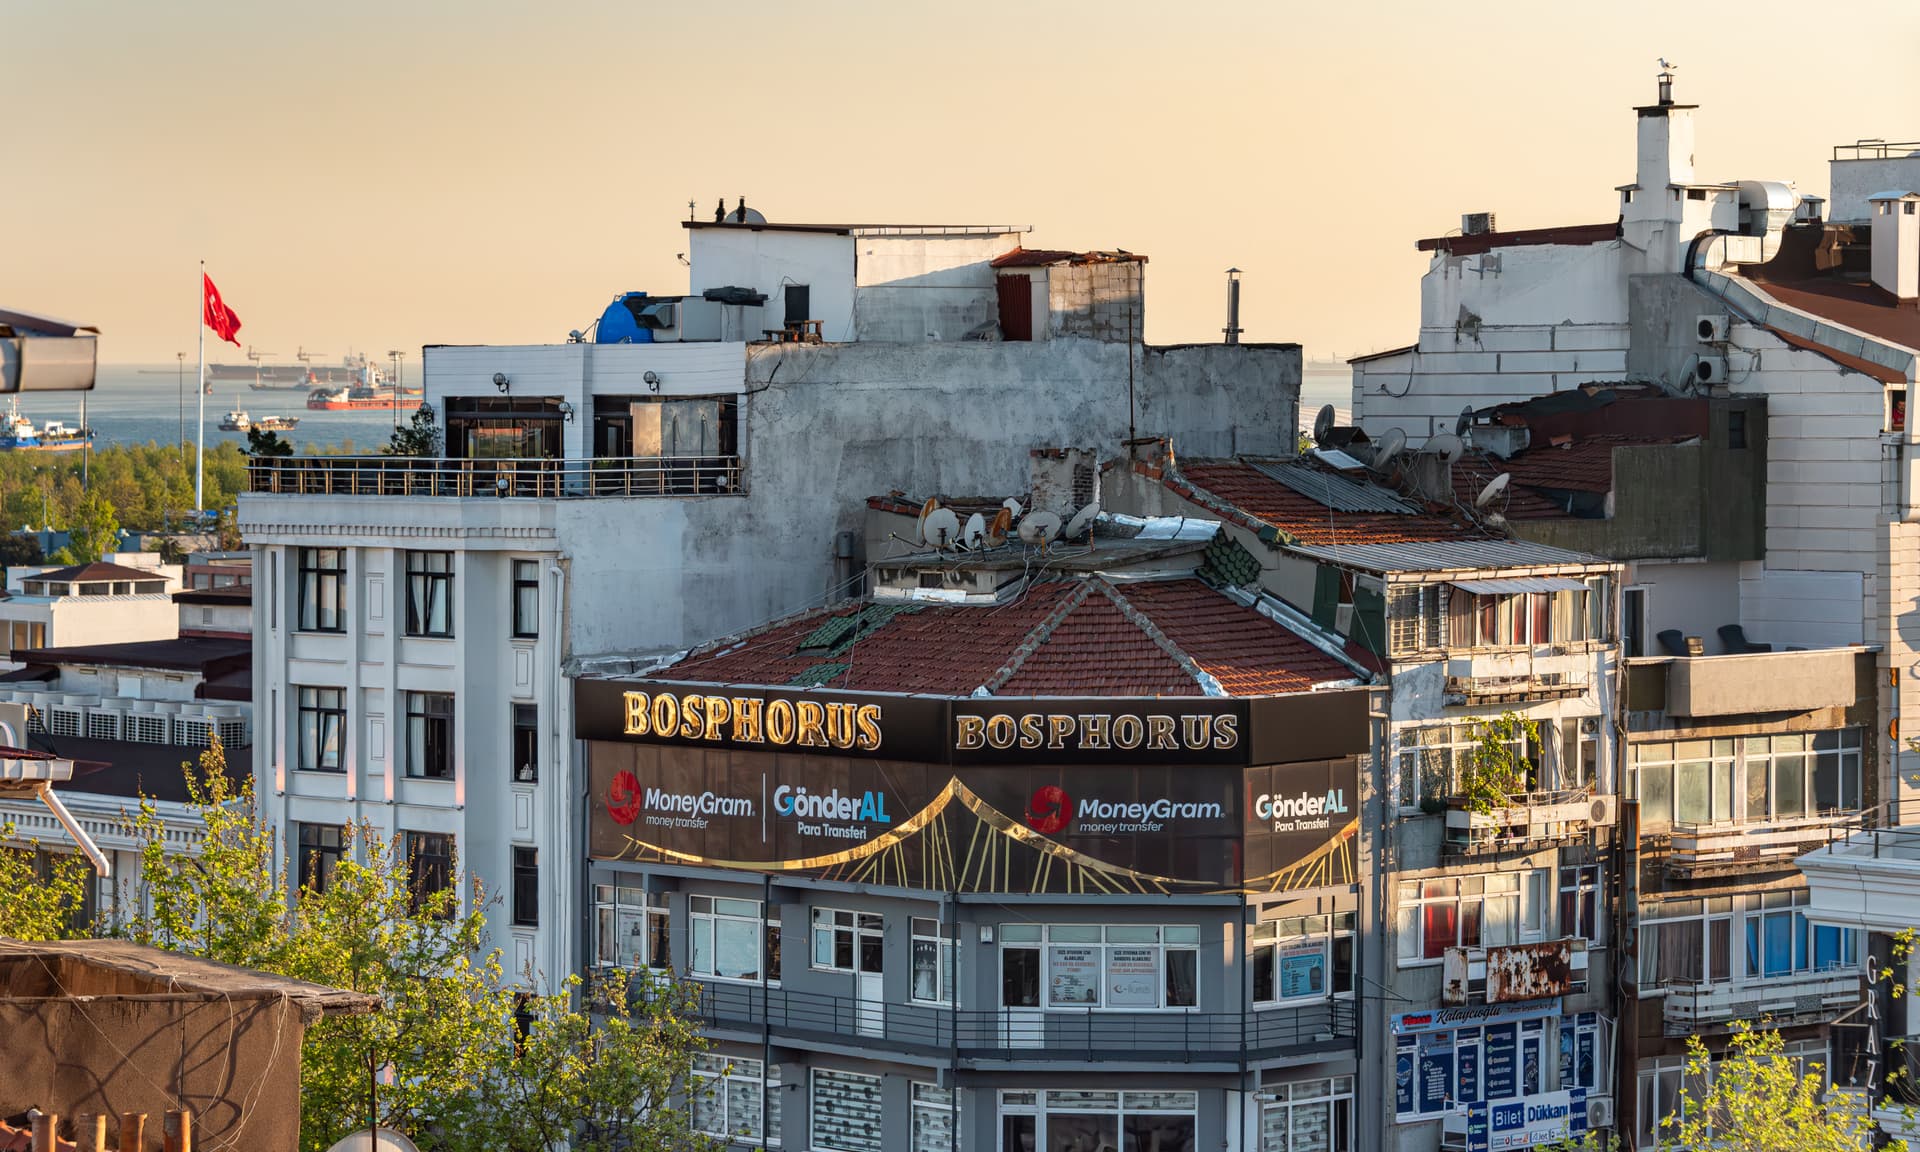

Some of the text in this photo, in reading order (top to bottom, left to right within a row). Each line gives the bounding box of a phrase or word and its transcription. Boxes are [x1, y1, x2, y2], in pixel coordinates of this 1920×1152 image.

[623, 690, 882, 751] BOSPHORUS
[956, 714, 1239, 750] BOSPHORUS
[773, 784, 891, 824] GönderAL
[1255, 788, 1348, 821] GönderAL
[646, 815, 709, 829] money transfer
[797, 822, 867, 840] Para Transferi
[1079, 821, 1164, 834] money transfer
[1274, 817, 1330, 832] Para Transferi
[1495, 1110, 1522, 1126] Bilet
